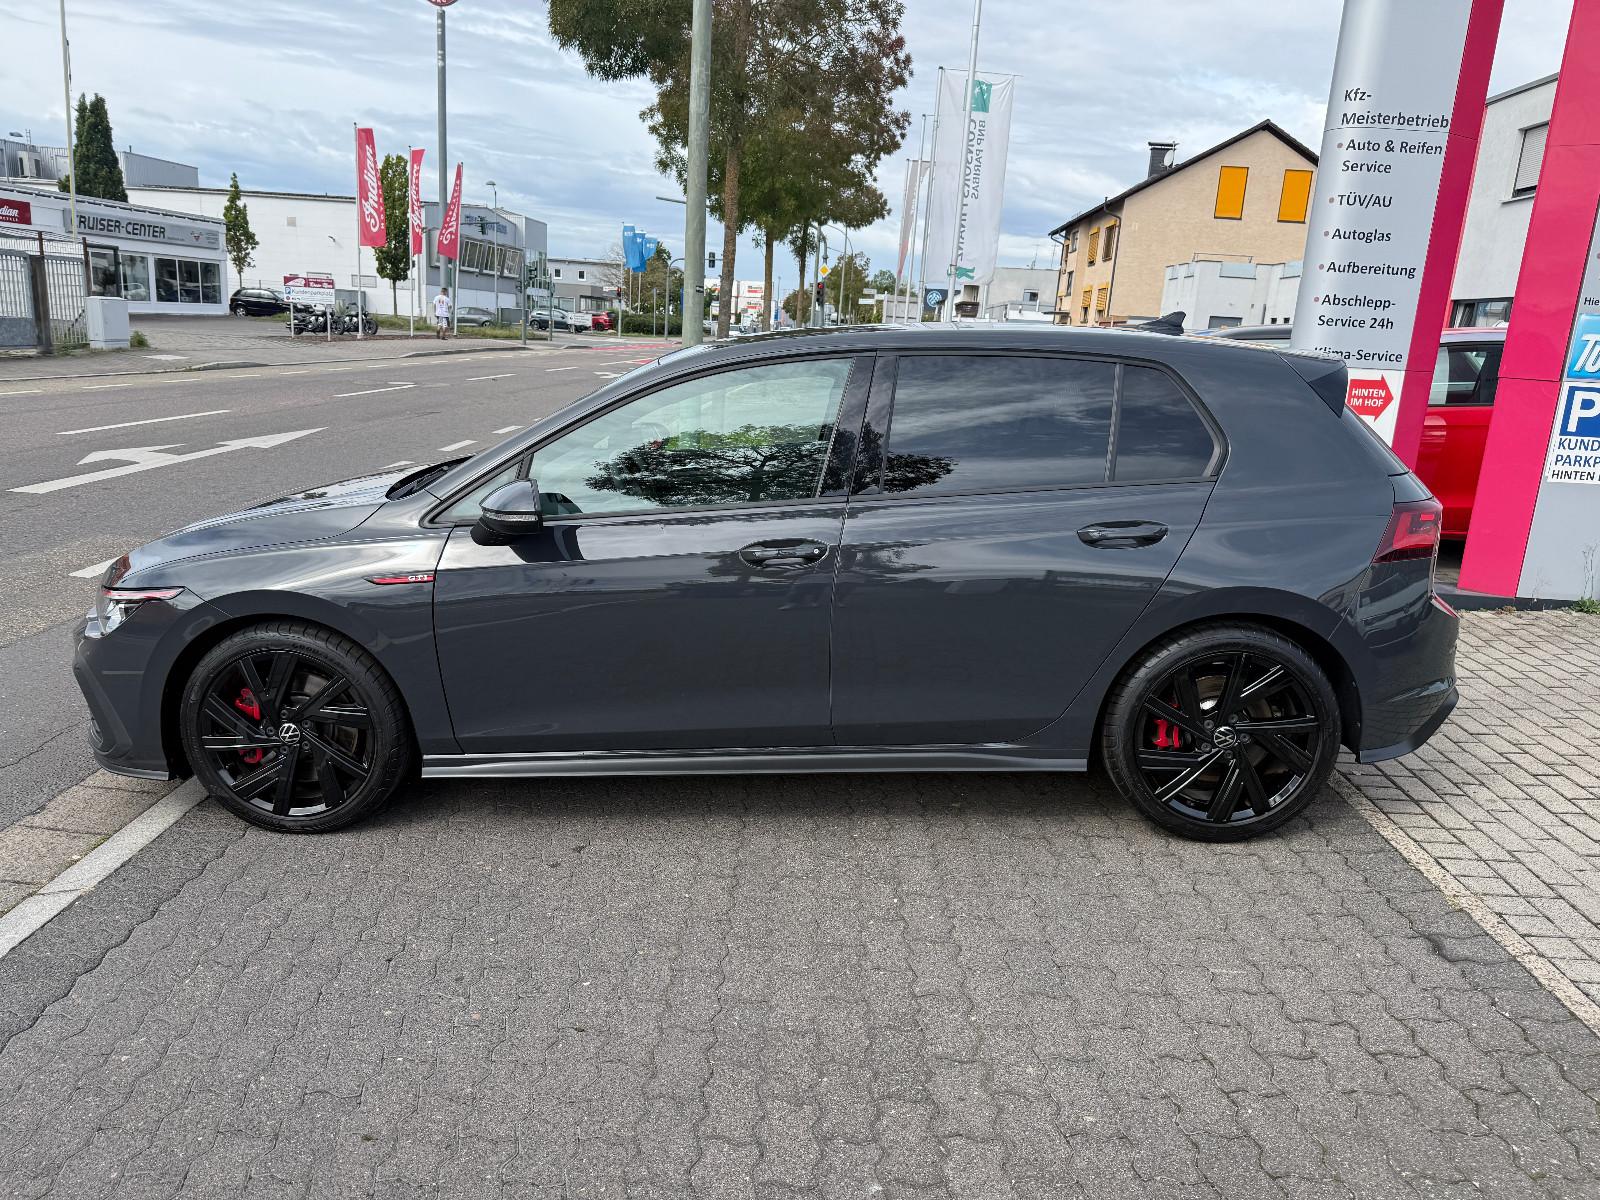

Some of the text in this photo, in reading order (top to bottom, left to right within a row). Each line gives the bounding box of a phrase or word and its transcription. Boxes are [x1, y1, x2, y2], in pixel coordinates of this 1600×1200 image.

[1344, 88, 1372, 102] Kfz-
[1341, 110, 1449, 128] Meisterbetrieb
[1345, 139, 1443, 154] Auto & Reifen
[1341, 160, 1392, 174] Service
[361, 144, 380, 233] Indian
[1337, 191, 1393, 209] TÜV/AU
[73, 214, 166, 239] RUISER-CENTER
[1331, 228, 1392, 244] Autoglas
[1326, 261, 1417, 279] Aufbereitung
[1321, 294, 1396, 311] Abschlepp-
[1584, 297, 1600, 306] Hie
[1317, 315, 1394, 330] Service 24h
[1314, 346, 1403, 362] ma-Service
[1351, 387, 1386, 398] HINTEN
[1350, 397, 1384, 408] IM HOF
[1557, 437, 1600, 452] KUND
[1554, 454, 1600, 468] PARKP
[1551, 469, 1596, 481] HINTEN
